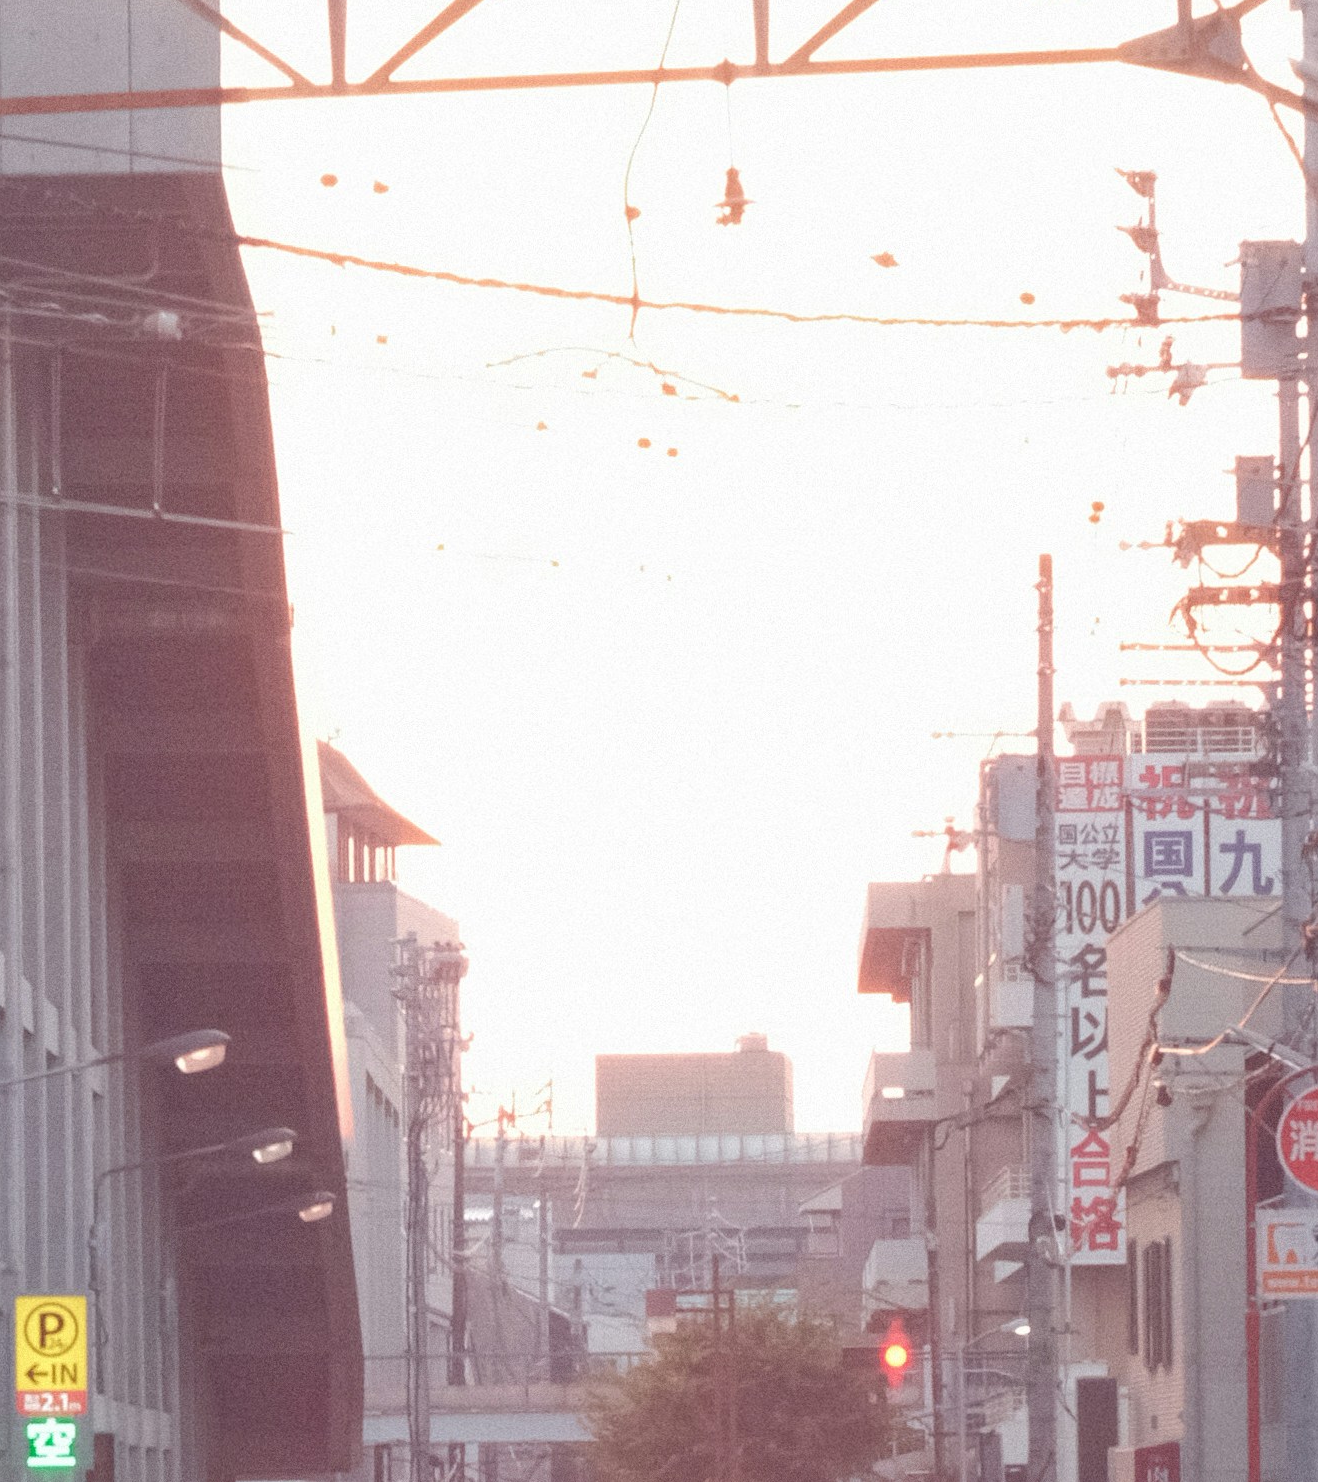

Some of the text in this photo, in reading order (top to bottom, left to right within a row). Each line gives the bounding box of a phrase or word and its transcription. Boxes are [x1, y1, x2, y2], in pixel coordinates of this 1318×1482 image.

[1058, 823, 1121, 845] 国公立
[1058, 849, 1121, 870] 大学
[39, 1312, 65, 1350] P
[51, 1363, 78, 1385] IN
[26, 1418, 76, 1468] 空
